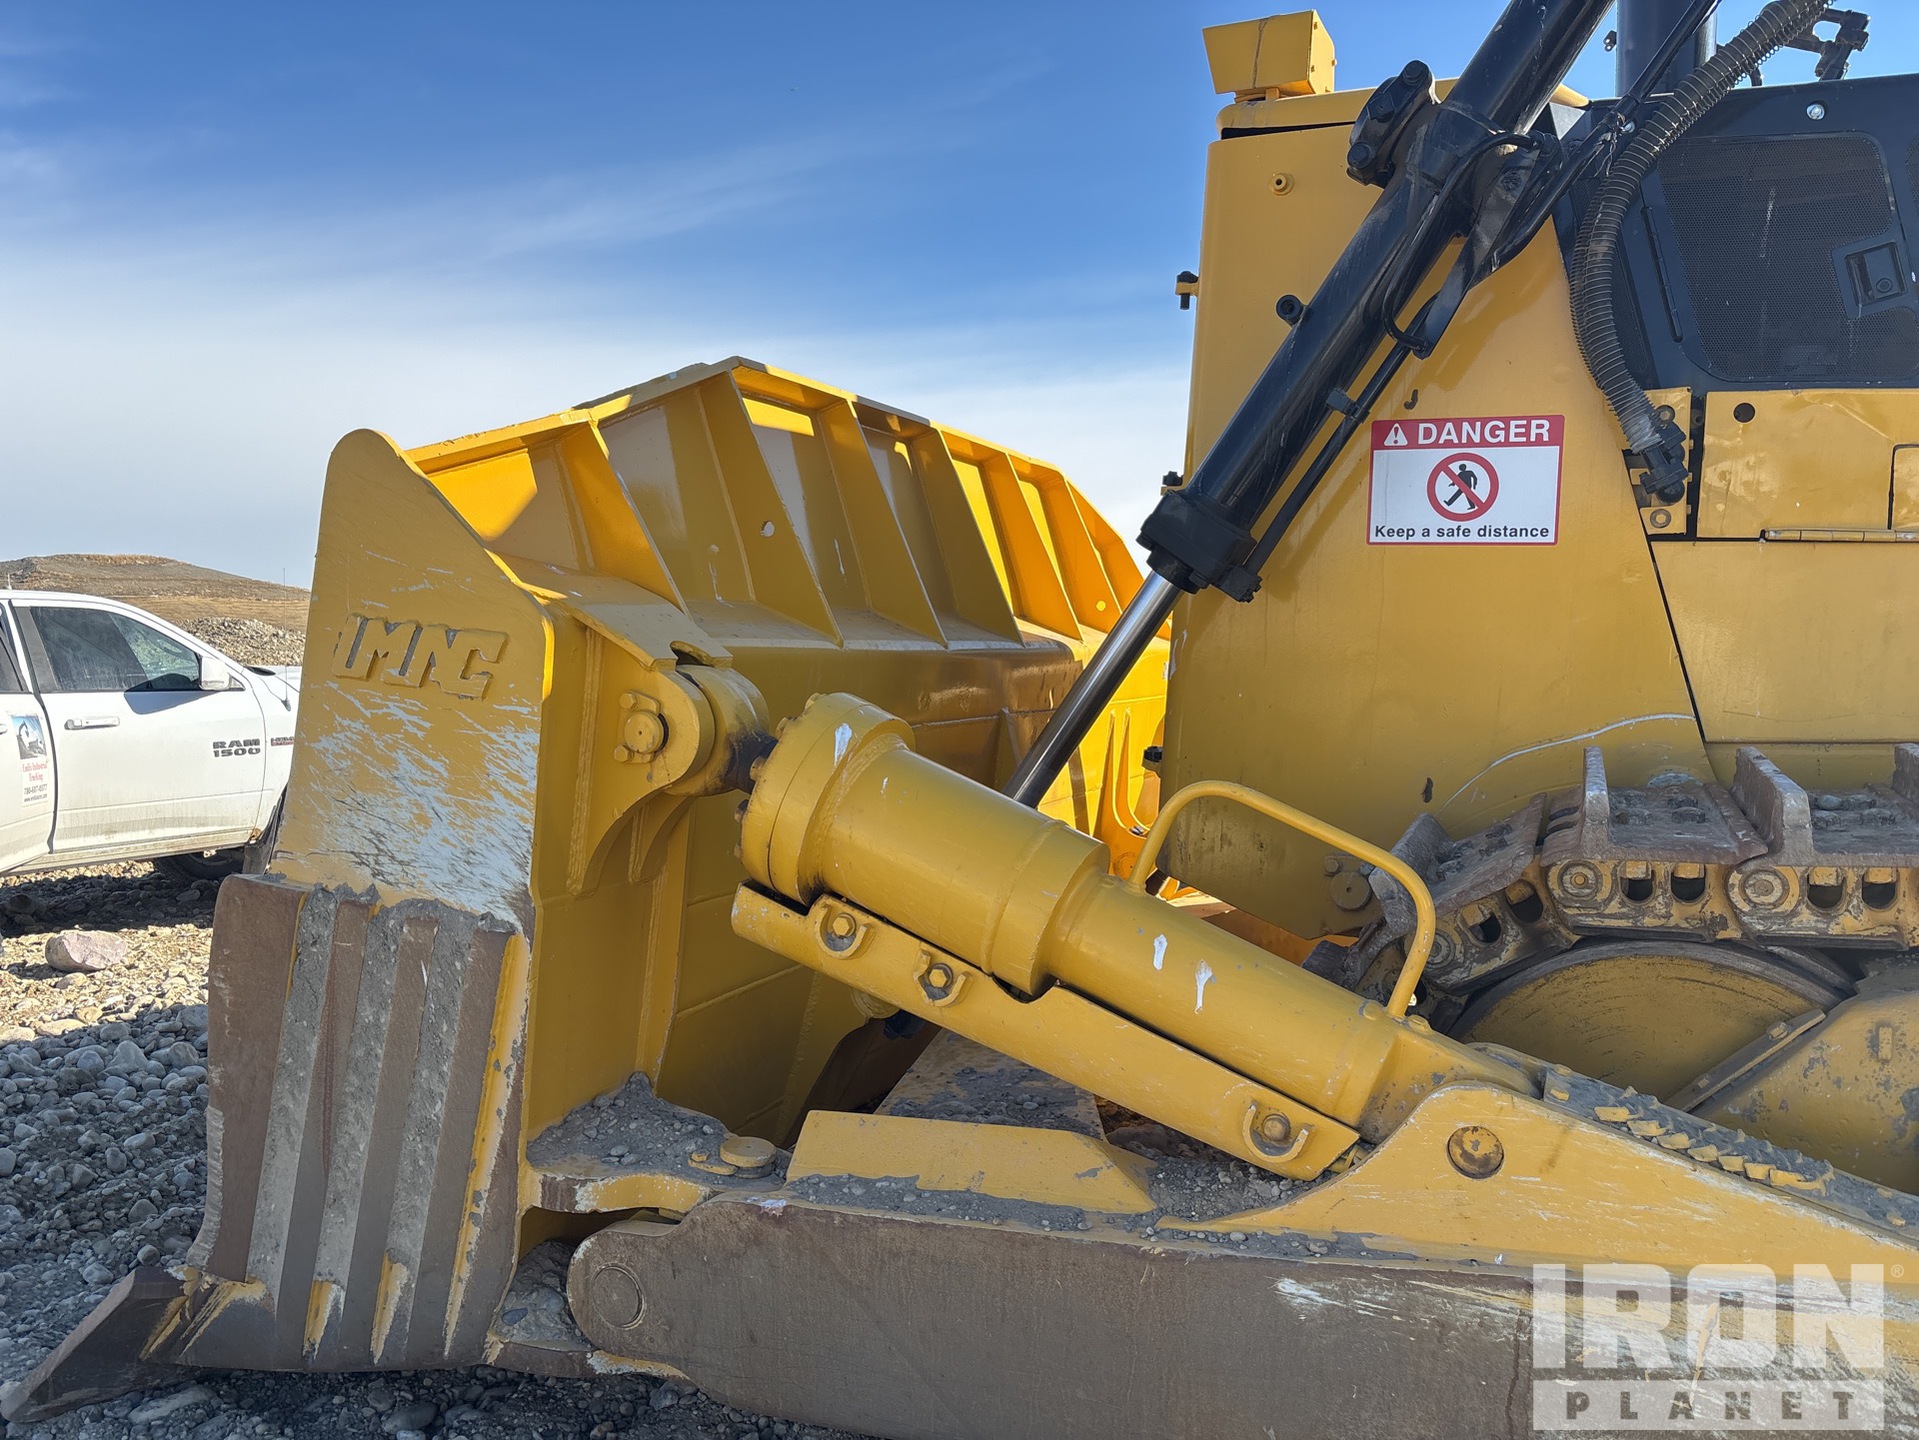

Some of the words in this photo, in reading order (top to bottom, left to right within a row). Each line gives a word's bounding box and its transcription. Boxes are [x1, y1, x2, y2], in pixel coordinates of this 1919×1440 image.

[1417, 419, 1551, 445] DANGER
[1375, 525, 1416, 540] Keep
[1421, 527, 1431, 538] a
[1436, 525, 1471, 538] safe
[1477, 525, 1550, 538] distance
[213, 738, 260, 749] RAM
[213, 748, 261, 757] 1500
